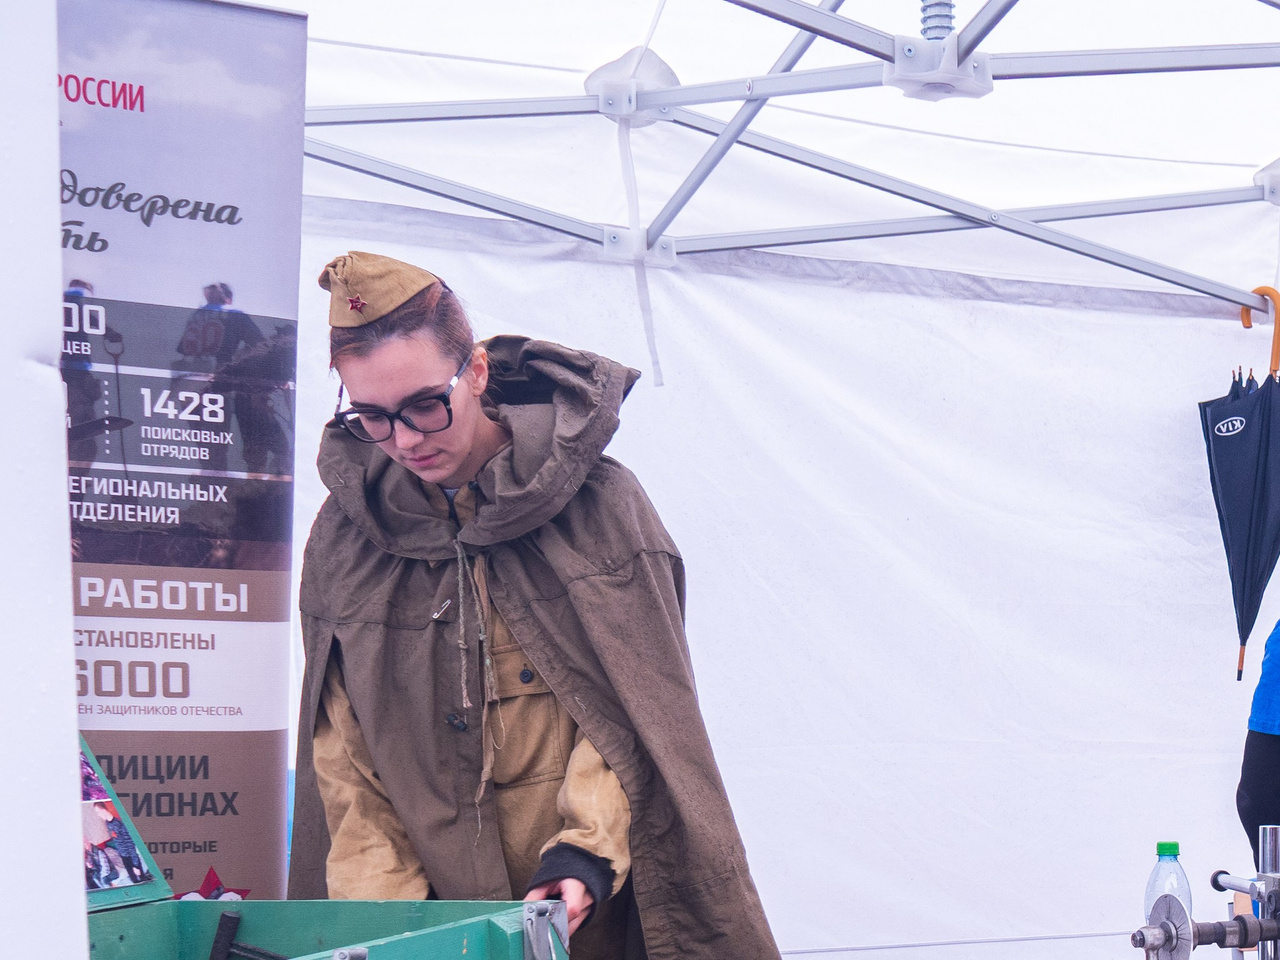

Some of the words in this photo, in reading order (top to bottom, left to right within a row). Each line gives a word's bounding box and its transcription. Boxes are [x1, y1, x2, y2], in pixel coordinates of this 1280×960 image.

[140, 388, 225, 423] 1428
[141, 426, 234, 445] ПОИСКОВЫХ
[141, 443, 210, 461] ОТРЯДОВ
[69, 476, 228, 503] ЕГИОНАЛЬНЫХ
[80, 576, 248, 613] РАБОТЫ
[96, 704, 177, 717] ЗАЩИТНИКОВ
[181, 705, 243, 717] ОТЕЧЕСТВА
[144, 841, 218, 854] ОТОРЫЕ
